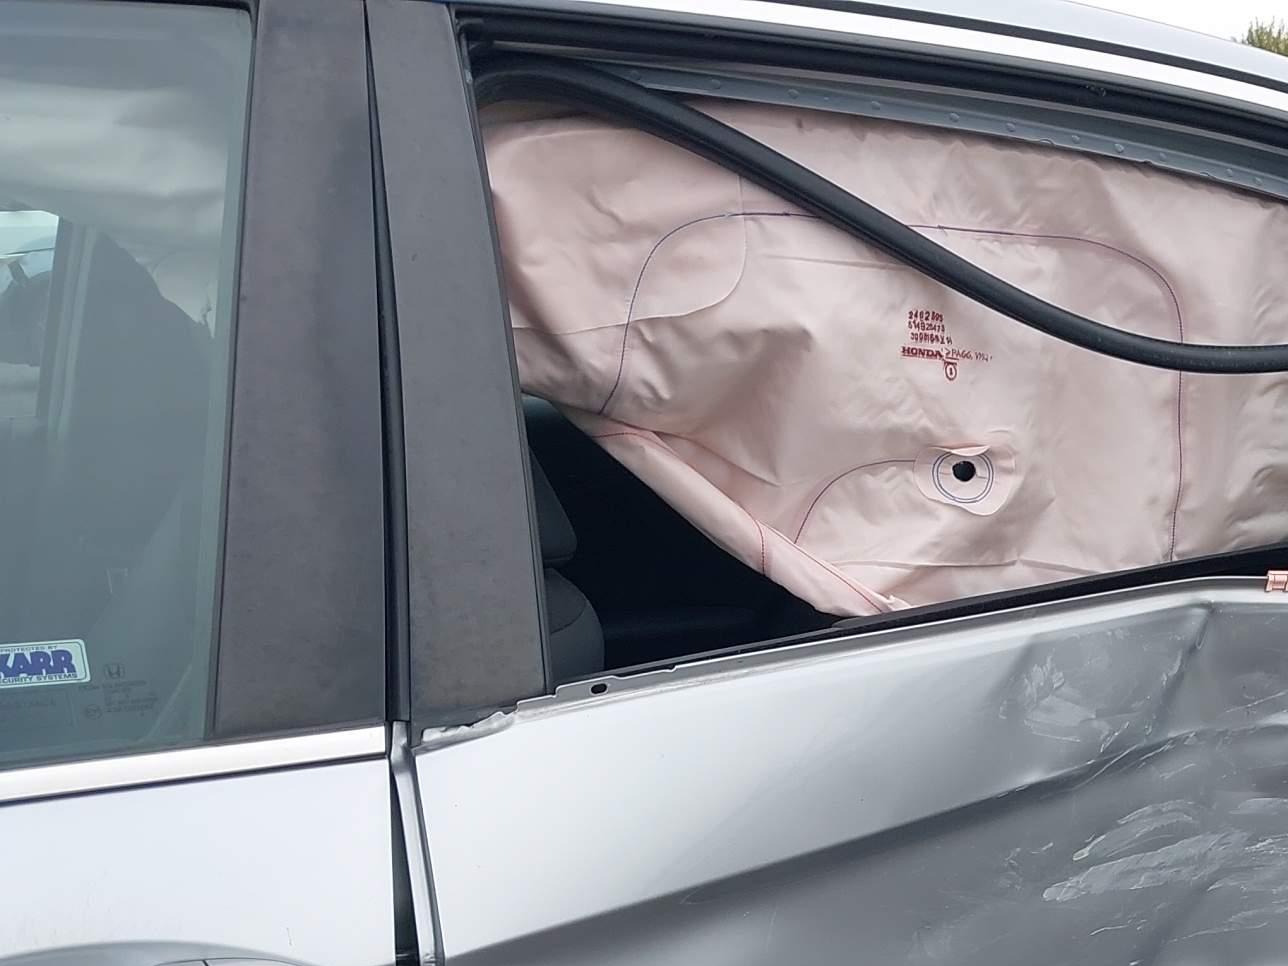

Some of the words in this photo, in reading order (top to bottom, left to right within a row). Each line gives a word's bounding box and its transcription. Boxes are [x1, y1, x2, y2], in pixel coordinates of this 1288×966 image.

[901, 346, 944, 358] HONDA
[0, 649, 77, 678] KARR
[36, 673, 78, 681] SYSTEMS
